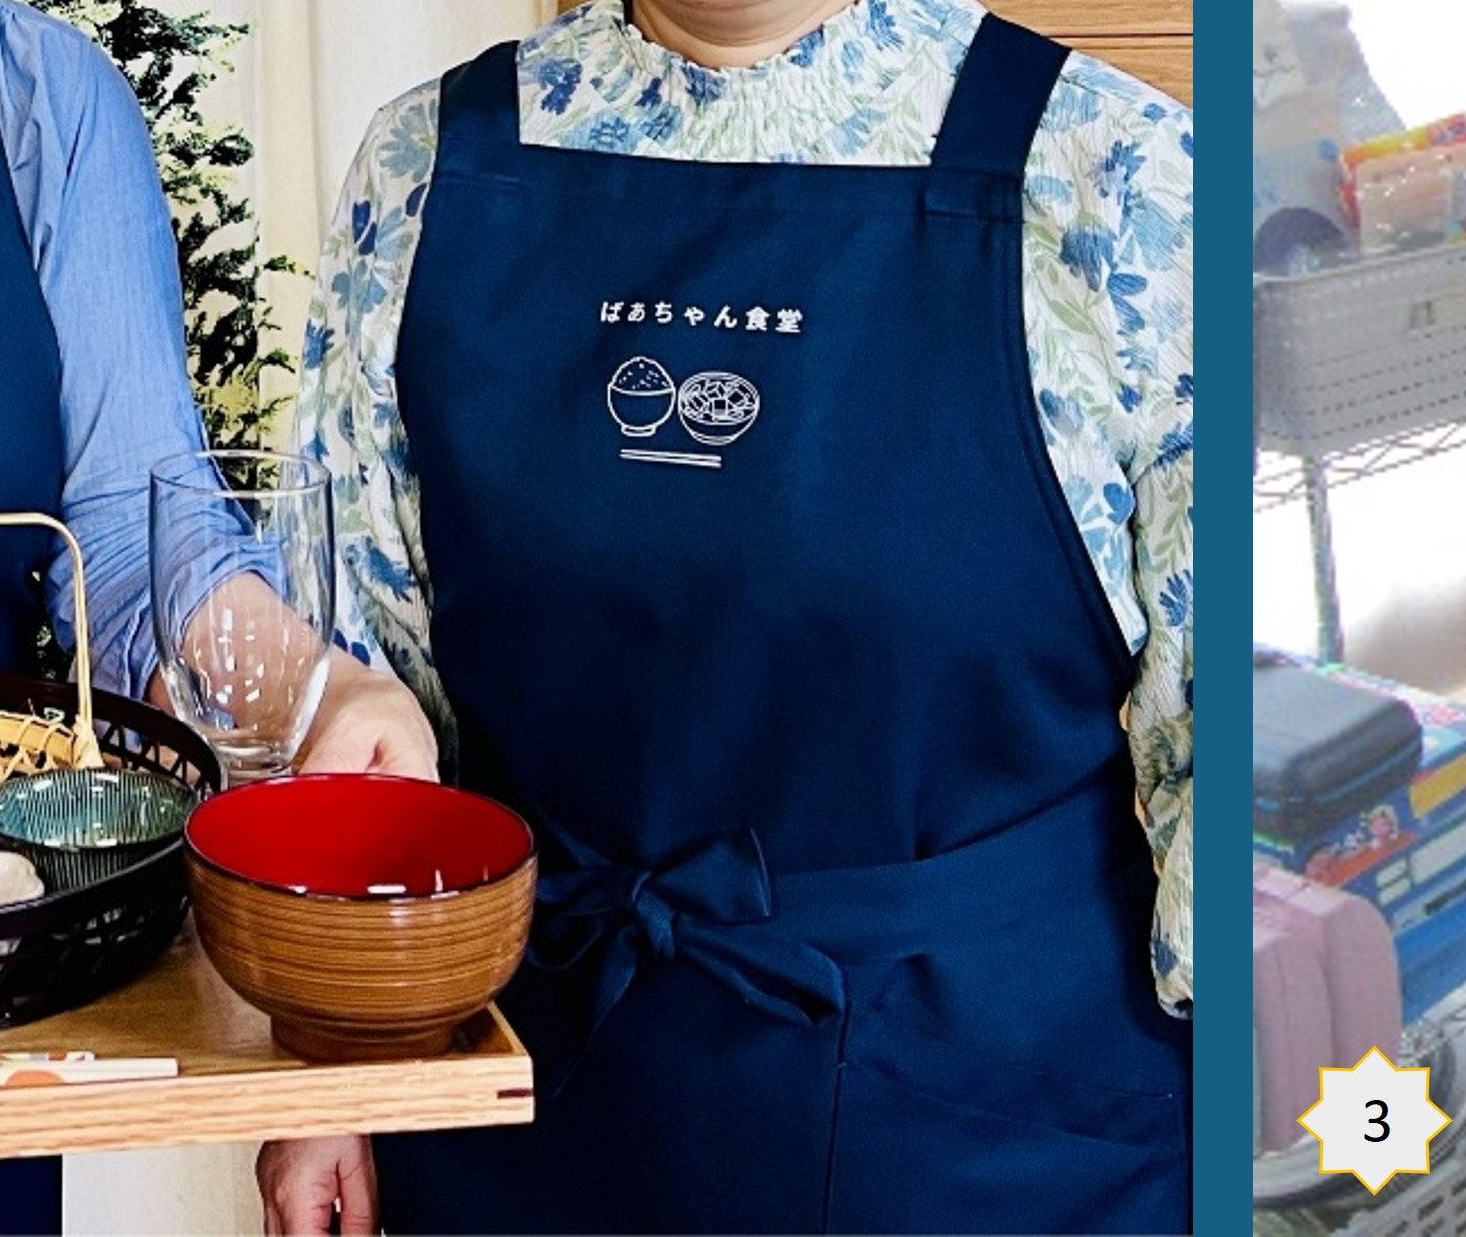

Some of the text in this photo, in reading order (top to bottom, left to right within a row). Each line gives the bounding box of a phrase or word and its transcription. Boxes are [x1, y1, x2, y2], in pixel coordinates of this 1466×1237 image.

[600, 301, 803, 333] ばあちゃん食堂
